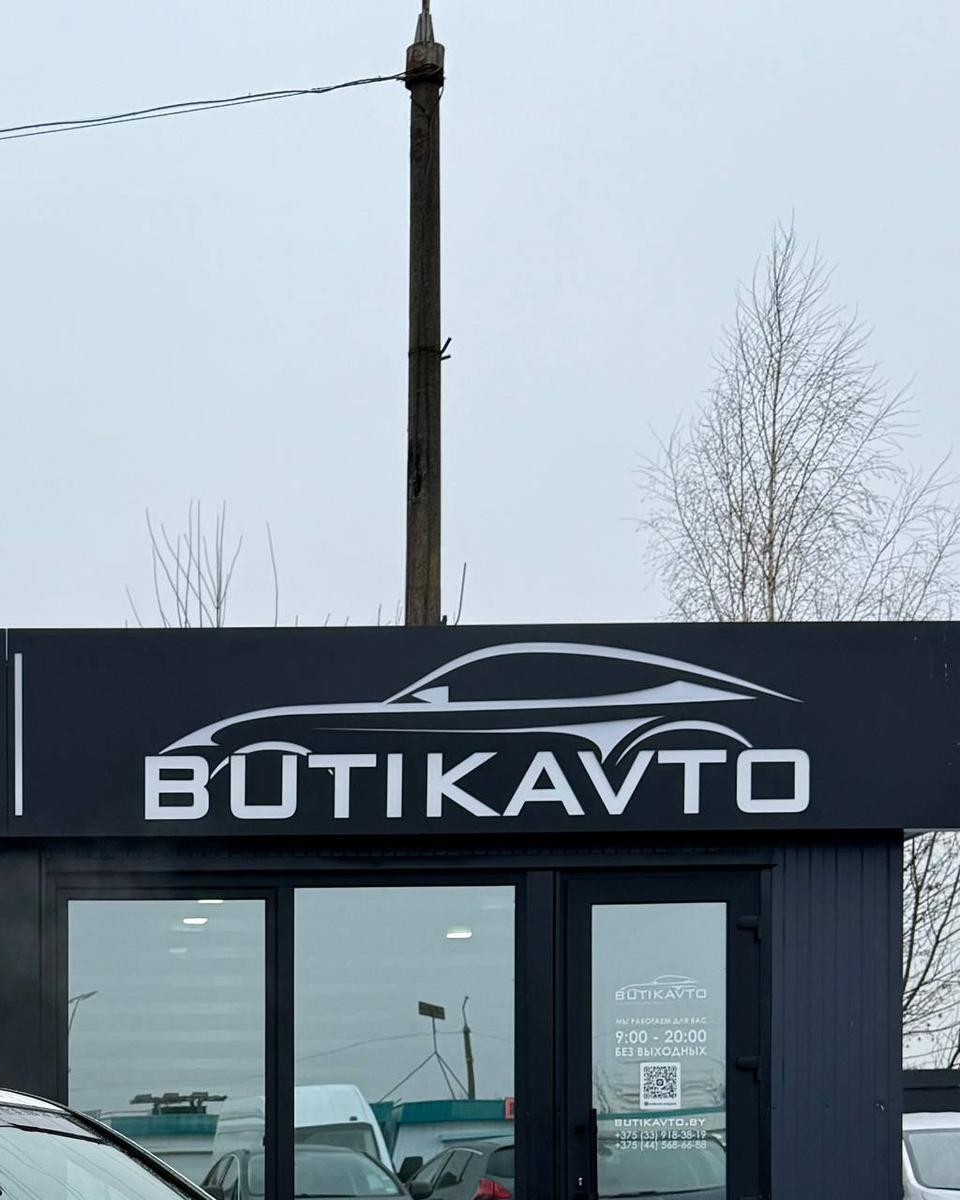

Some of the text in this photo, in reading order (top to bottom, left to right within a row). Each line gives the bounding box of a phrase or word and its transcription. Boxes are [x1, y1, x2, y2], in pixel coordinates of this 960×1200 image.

[143, 747, 810, 821] BUTIKAVTO
[615, 989, 707, 1001] BUTIKAVTO
[615, 1030, 648, 1044] 9:00
[664, 1029, 707, 1043] 20:00
[615, 1046, 706, 1057] БЕЗ ВЫХОДНЫХ
[614, 1118, 706, 1127] BUTIKAVTO.BY
[615, 1129, 707, 1141] +375 (33) 918-38-19
[615, 1140, 638, 1150] +375
[640, 1140, 658, 1151] (44)
